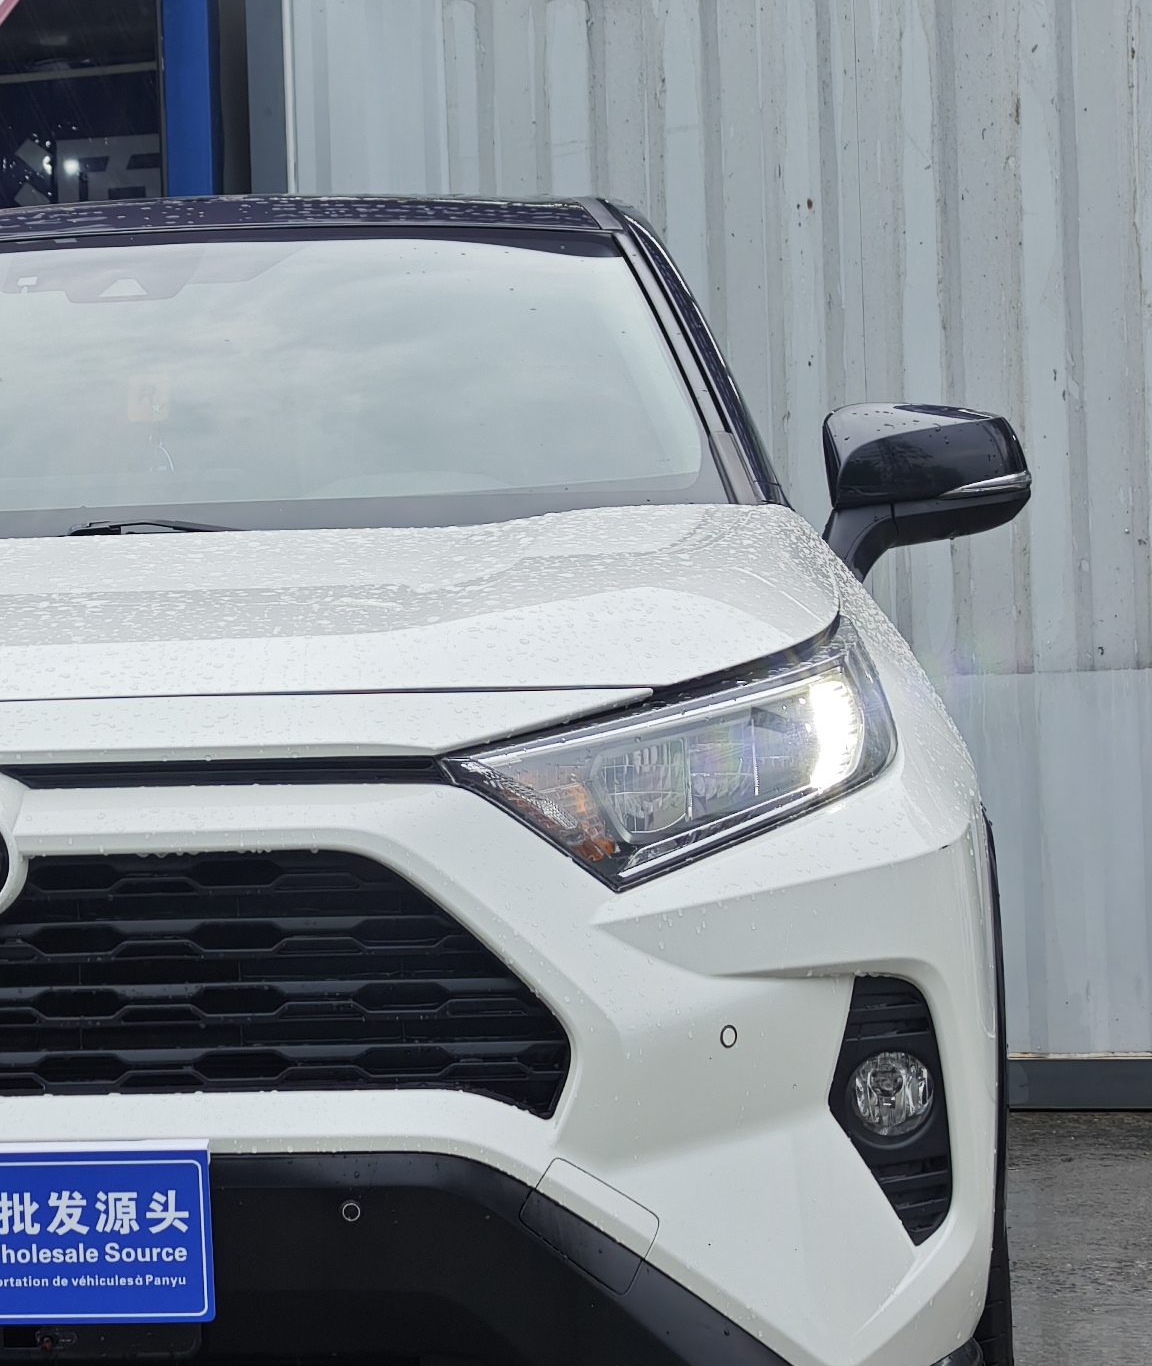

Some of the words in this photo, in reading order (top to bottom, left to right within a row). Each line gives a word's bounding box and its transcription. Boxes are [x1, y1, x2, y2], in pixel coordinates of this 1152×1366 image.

[104, 1242, 188, 1263] Source
[52, 1275, 69, 1287] de
[145, 1274, 187, 1288] Panyu
